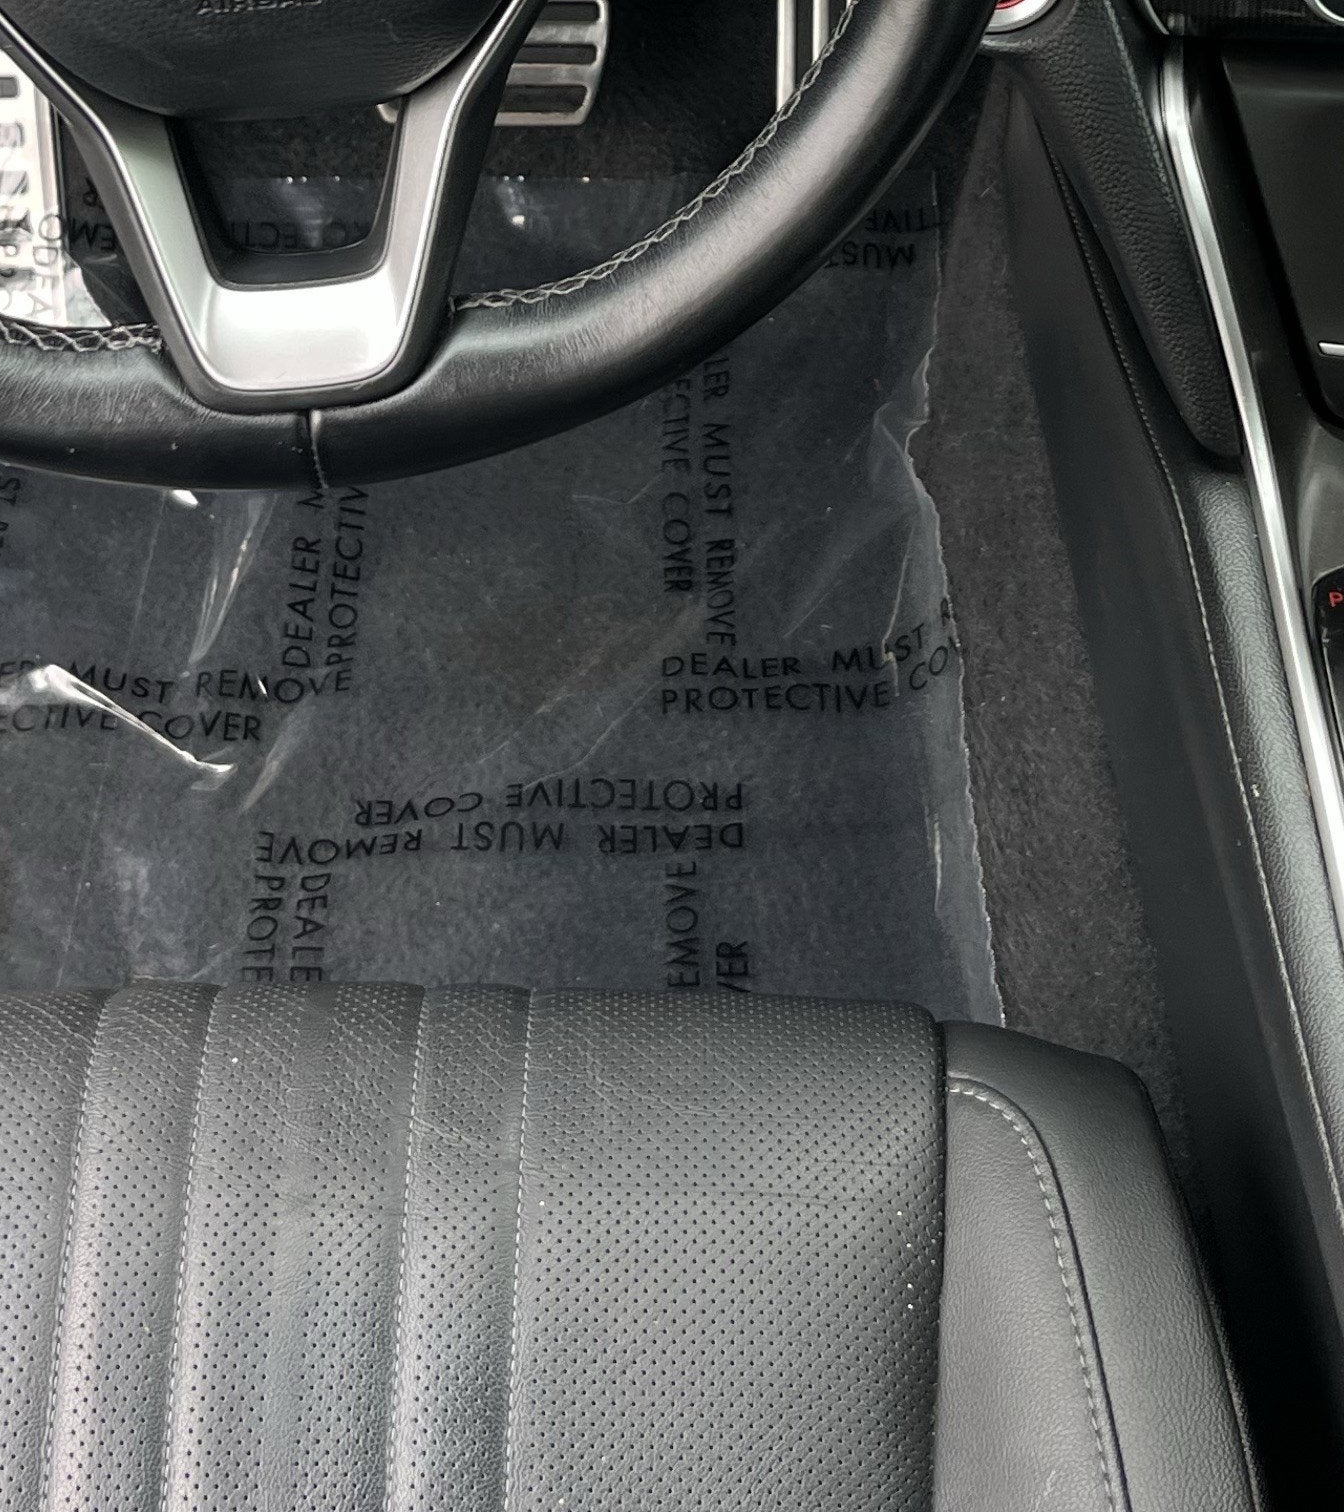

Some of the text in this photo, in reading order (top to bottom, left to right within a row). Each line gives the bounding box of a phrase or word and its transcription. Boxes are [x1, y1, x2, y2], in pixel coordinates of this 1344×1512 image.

[704, 423, 733, 519] MUST
[662, 492, 694, 593] COVER
[282, 536, 322, 668] DEALER
[706, 539, 737, 647] REMOVE
[1329, 591, 1344, 607] P
[661, 622, 924, 679] DEALER MUST
[67, 661, 179, 704] MUST
[196, 669, 353, 704] REMOVE
[661, 681, 891, 714] PROTECTIVE
[143, 709, 263, 742] COVER
[355, 778, 744, 826] PROTECTIVE COVER
[255, 820, 744, 865] DEALER MUST REMOVE
